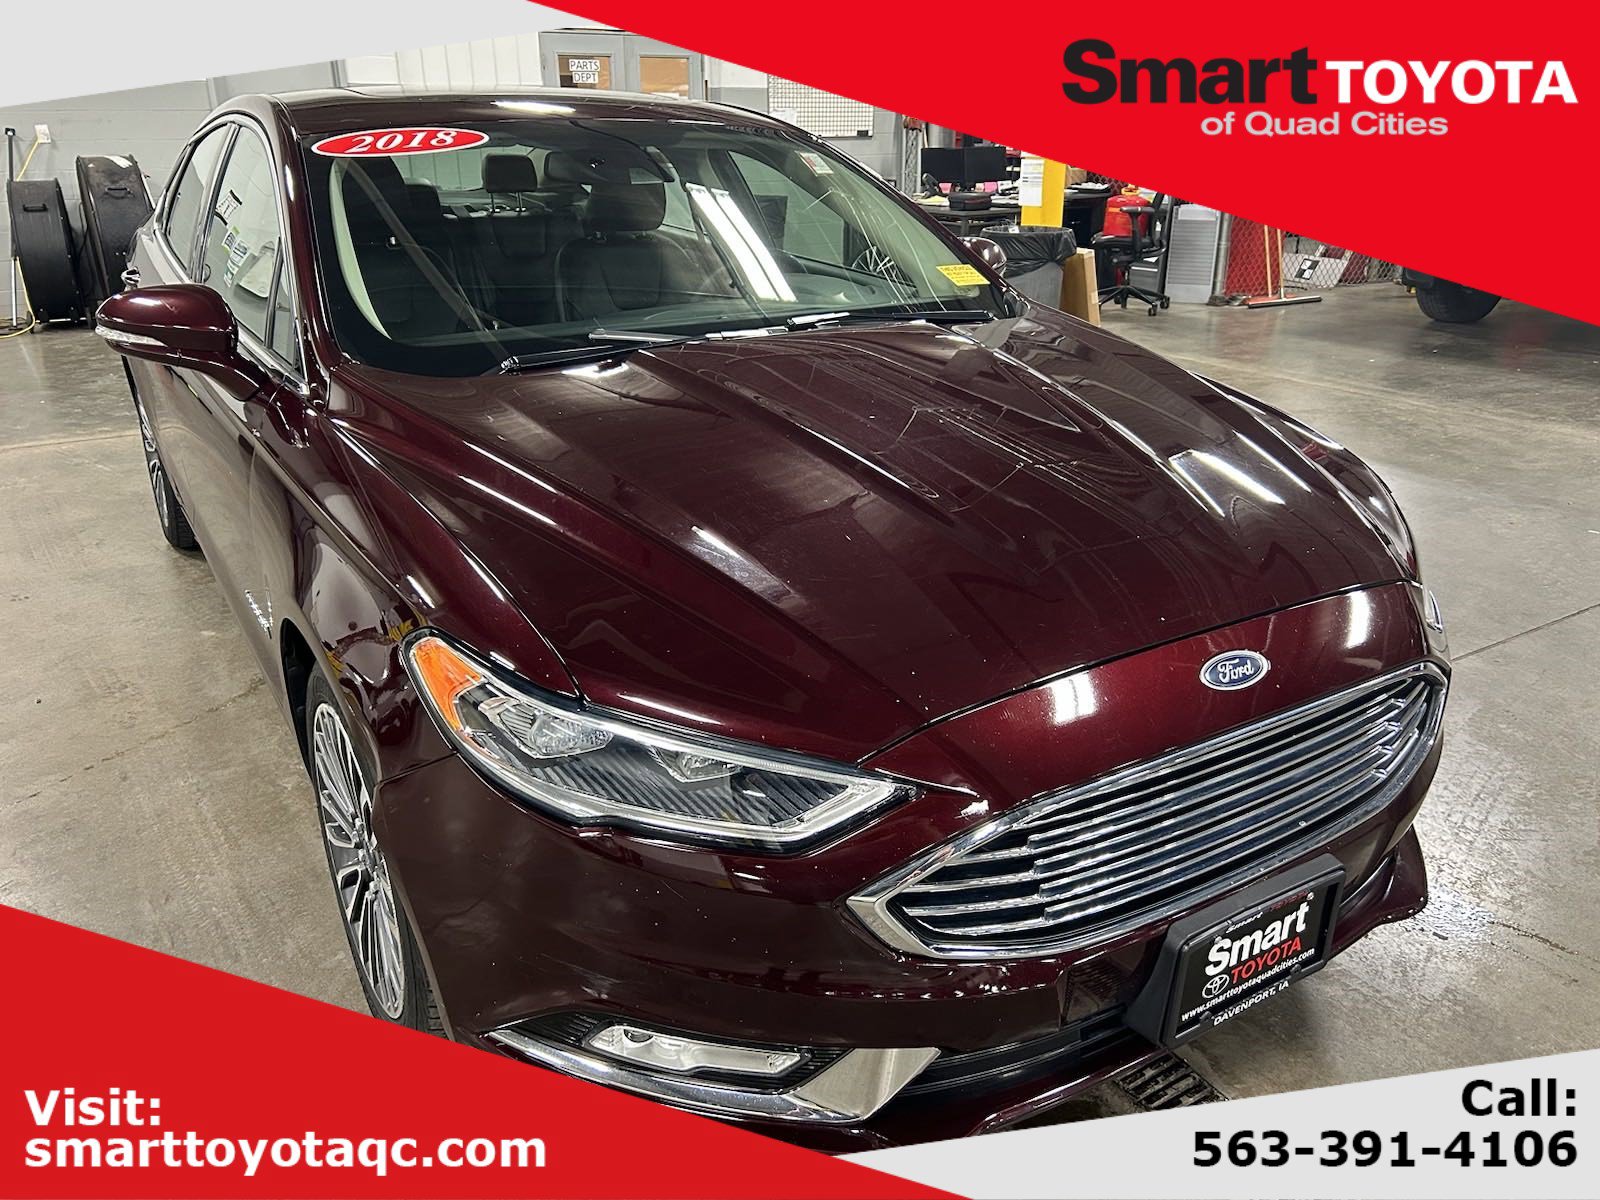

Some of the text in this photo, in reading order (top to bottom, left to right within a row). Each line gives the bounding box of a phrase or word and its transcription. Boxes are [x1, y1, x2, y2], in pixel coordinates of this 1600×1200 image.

[570, 60, 599, 70] PARTS
[574, 73, 597, 82] DEPT
[344, 131, 458, 153] 2018
[1217, 658, 1254, 683] Ford
[1205, 901, 1309, 976] Smart
[1231, 936, 1301, 984] TOYOTA
[1181, 948, 1315, 1022] www.smarttoyotaquadcities.com
